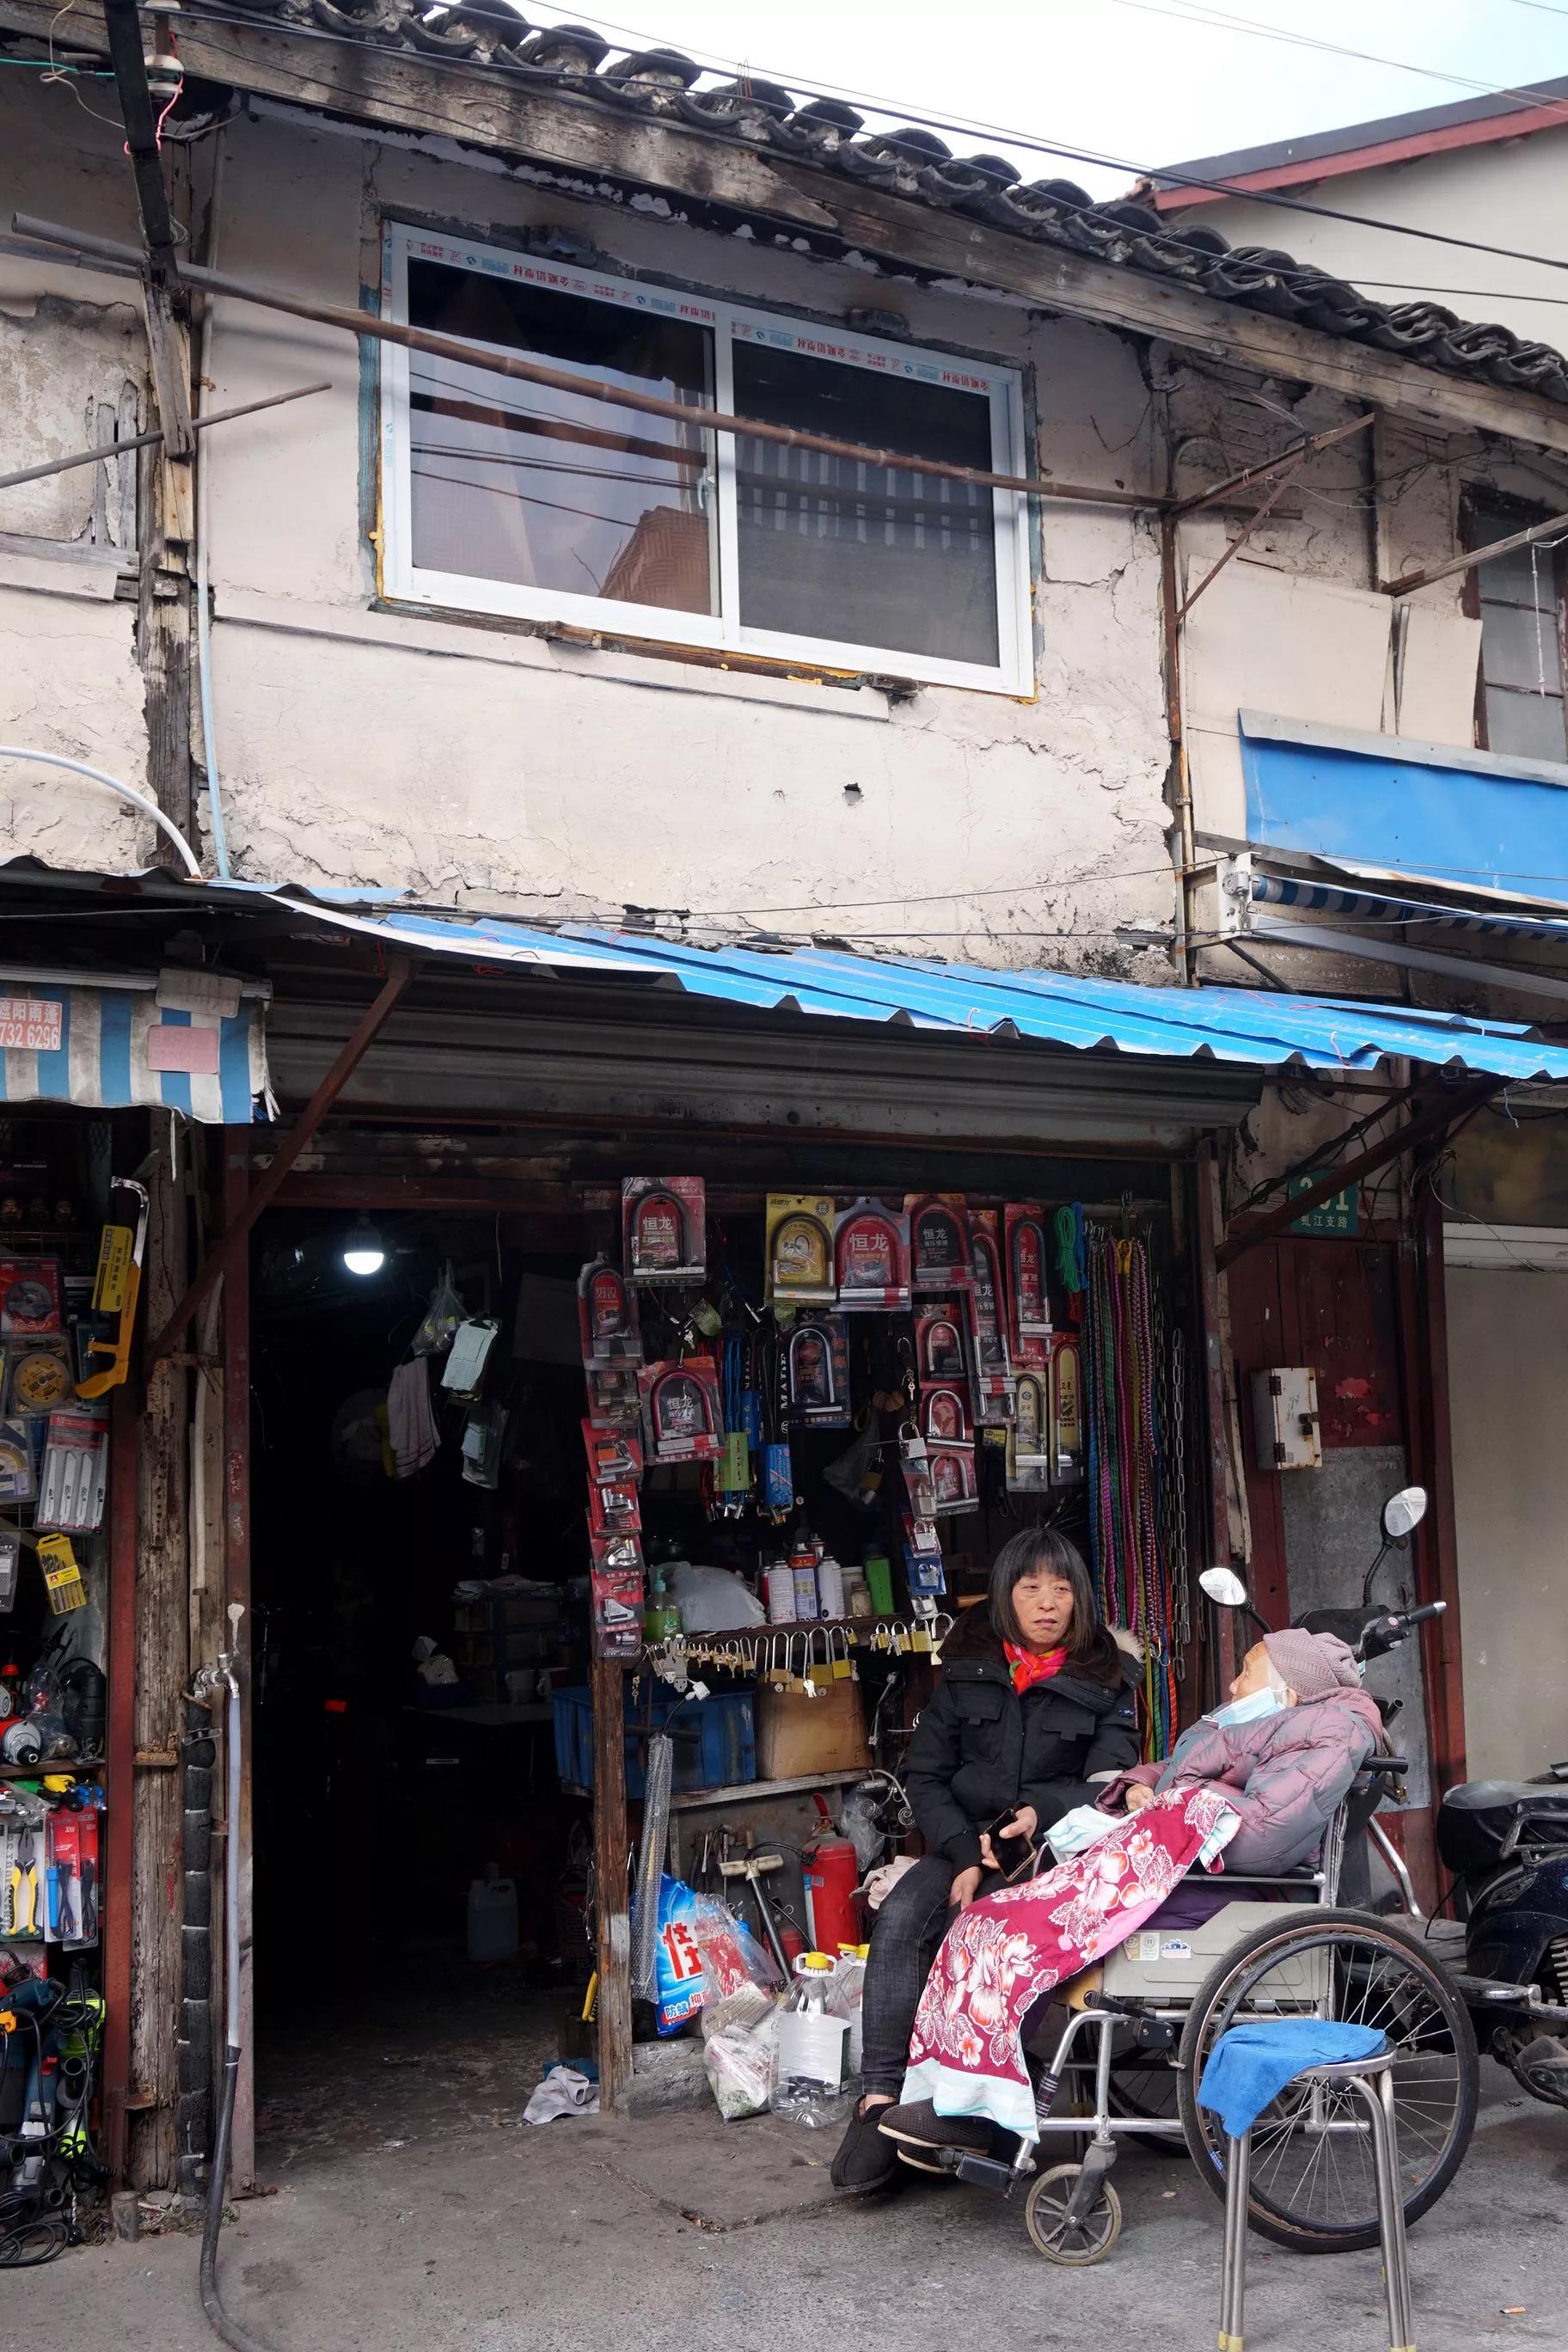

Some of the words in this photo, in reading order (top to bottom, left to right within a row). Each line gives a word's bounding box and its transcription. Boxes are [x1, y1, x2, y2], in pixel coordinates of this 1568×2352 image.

[28, 1024, 59, 1049] 6296
[642, 1216, 673, 1230] 恒龙
[1301, 1215, 1348, 1228] 虬江支路
[922, 1228, 947, 1240] 恒龙
[849, 1234, 889, 1252] 恒龙
[666, 1397, 694, 1410] 恒龙
